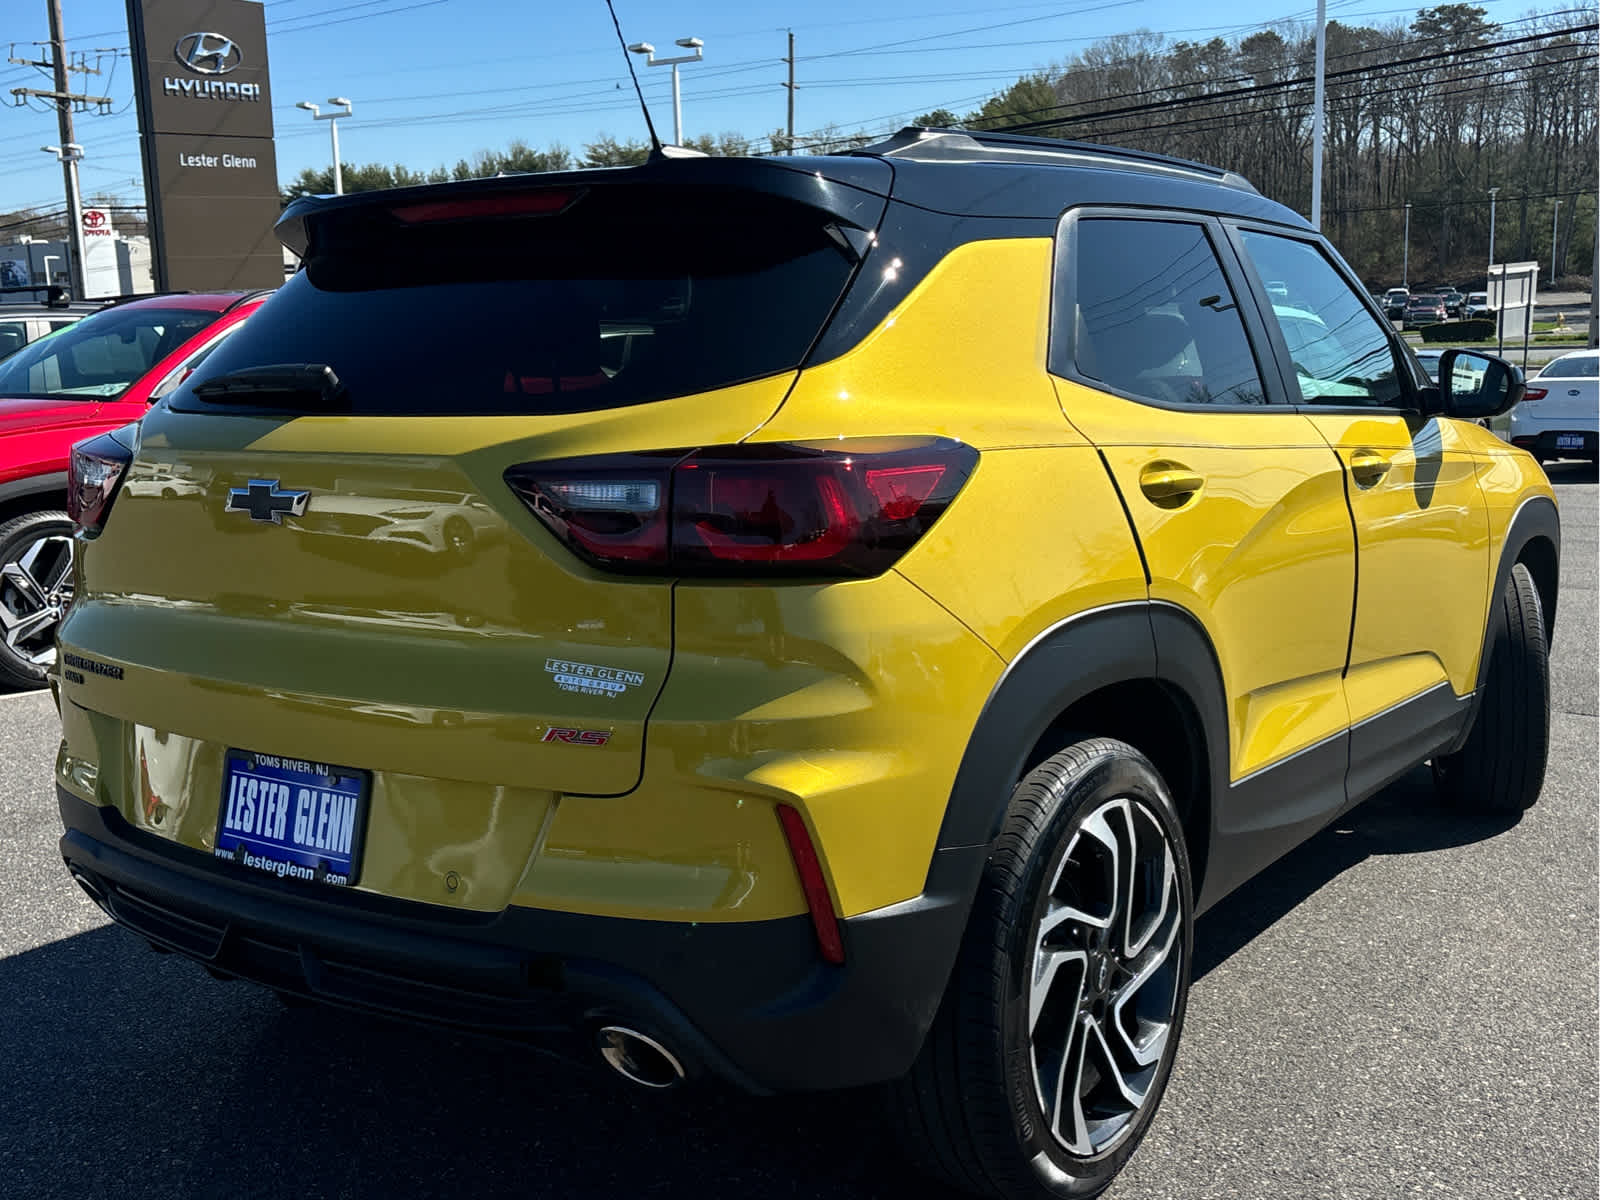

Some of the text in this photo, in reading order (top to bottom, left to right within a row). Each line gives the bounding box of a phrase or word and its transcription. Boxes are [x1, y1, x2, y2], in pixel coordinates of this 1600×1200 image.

[164, 77, 260, 101] HYUNDAI
[179, 152, 257, 169] Lester Glenn
[545, 660, 645, 685] LESTER GLENN
[558, 683, 579, 692] TOMS
[541, 727, 612, 746] RS
[255, 753, 329, 776] TOMS RIVER, NJ
[224, 774, 357, 854] LESTER GLENN
[243, 851, 314, 880] lesterglenn
[323, 872, 347, 886] .com
